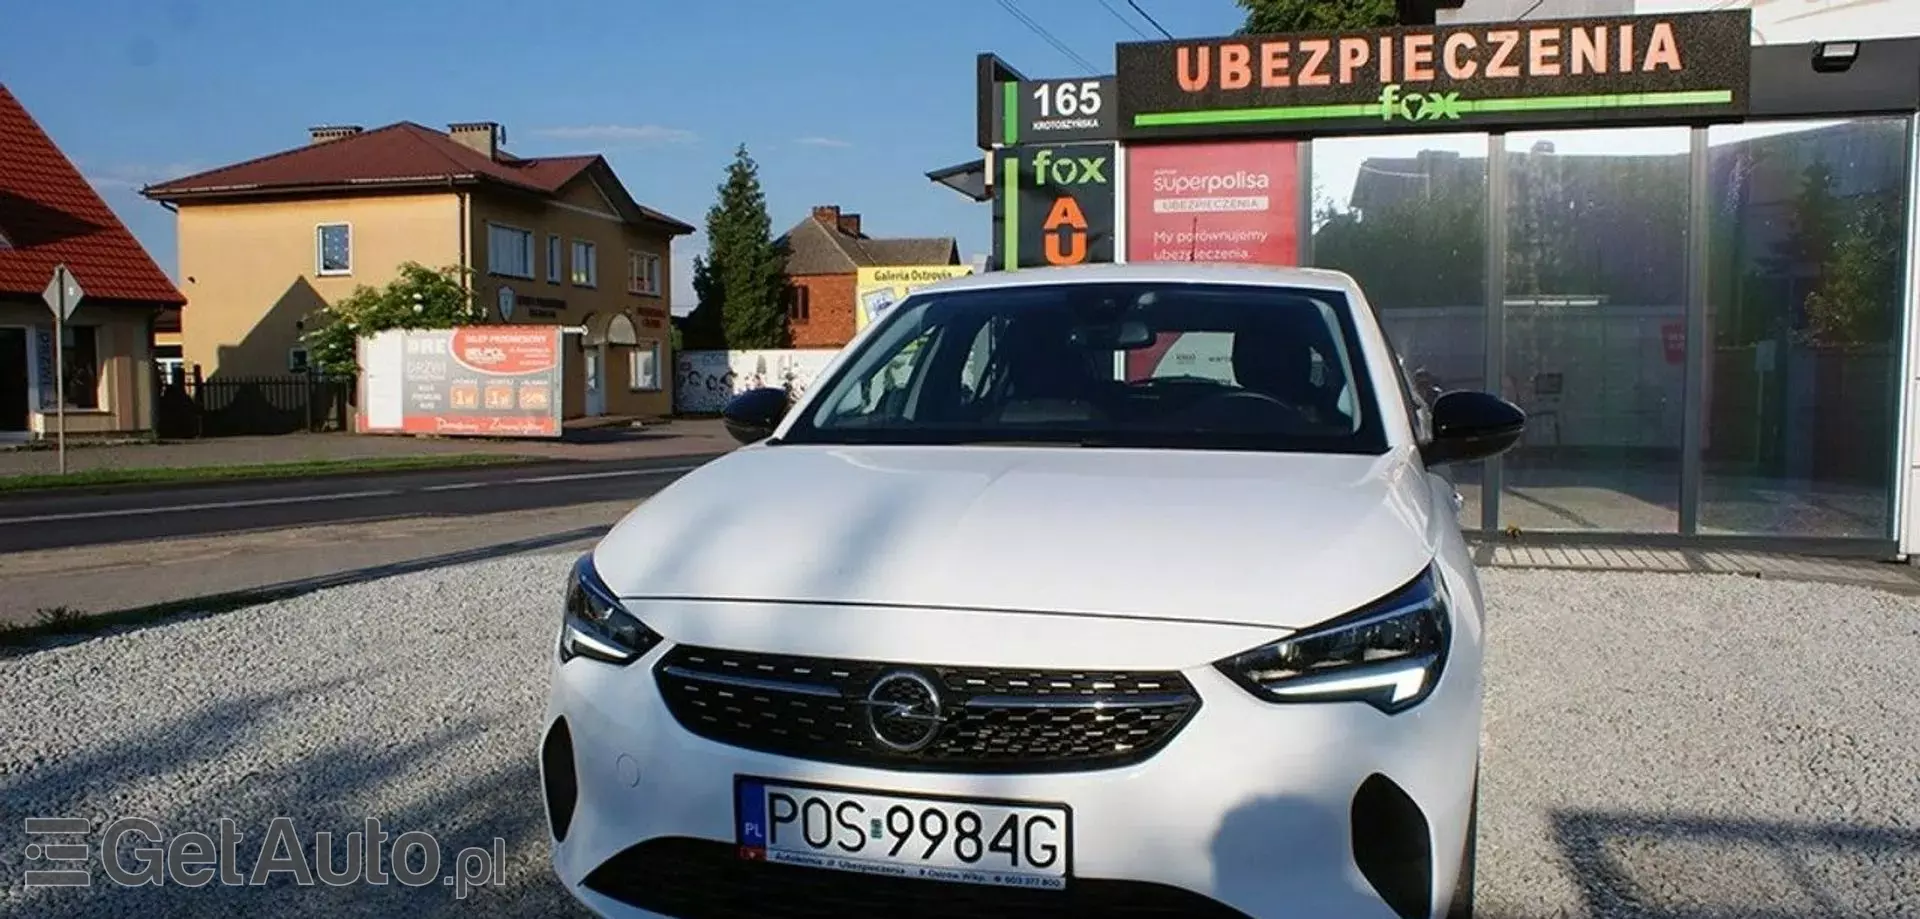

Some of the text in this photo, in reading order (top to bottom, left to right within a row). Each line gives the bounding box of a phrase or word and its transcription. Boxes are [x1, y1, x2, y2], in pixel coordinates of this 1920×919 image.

[1175, 21, 1684, 93] UBEZPIECZENIA
[1033, 81, 1101, 117] 165
[1378, 83, 1461, 121] fox
[1032, 149, 1107, 185] fox
[1153, 170, 1269, 194] superpolisa
[744, 822, 763, 838] PL
[769, 792, 1058, 869] POS 9984G
